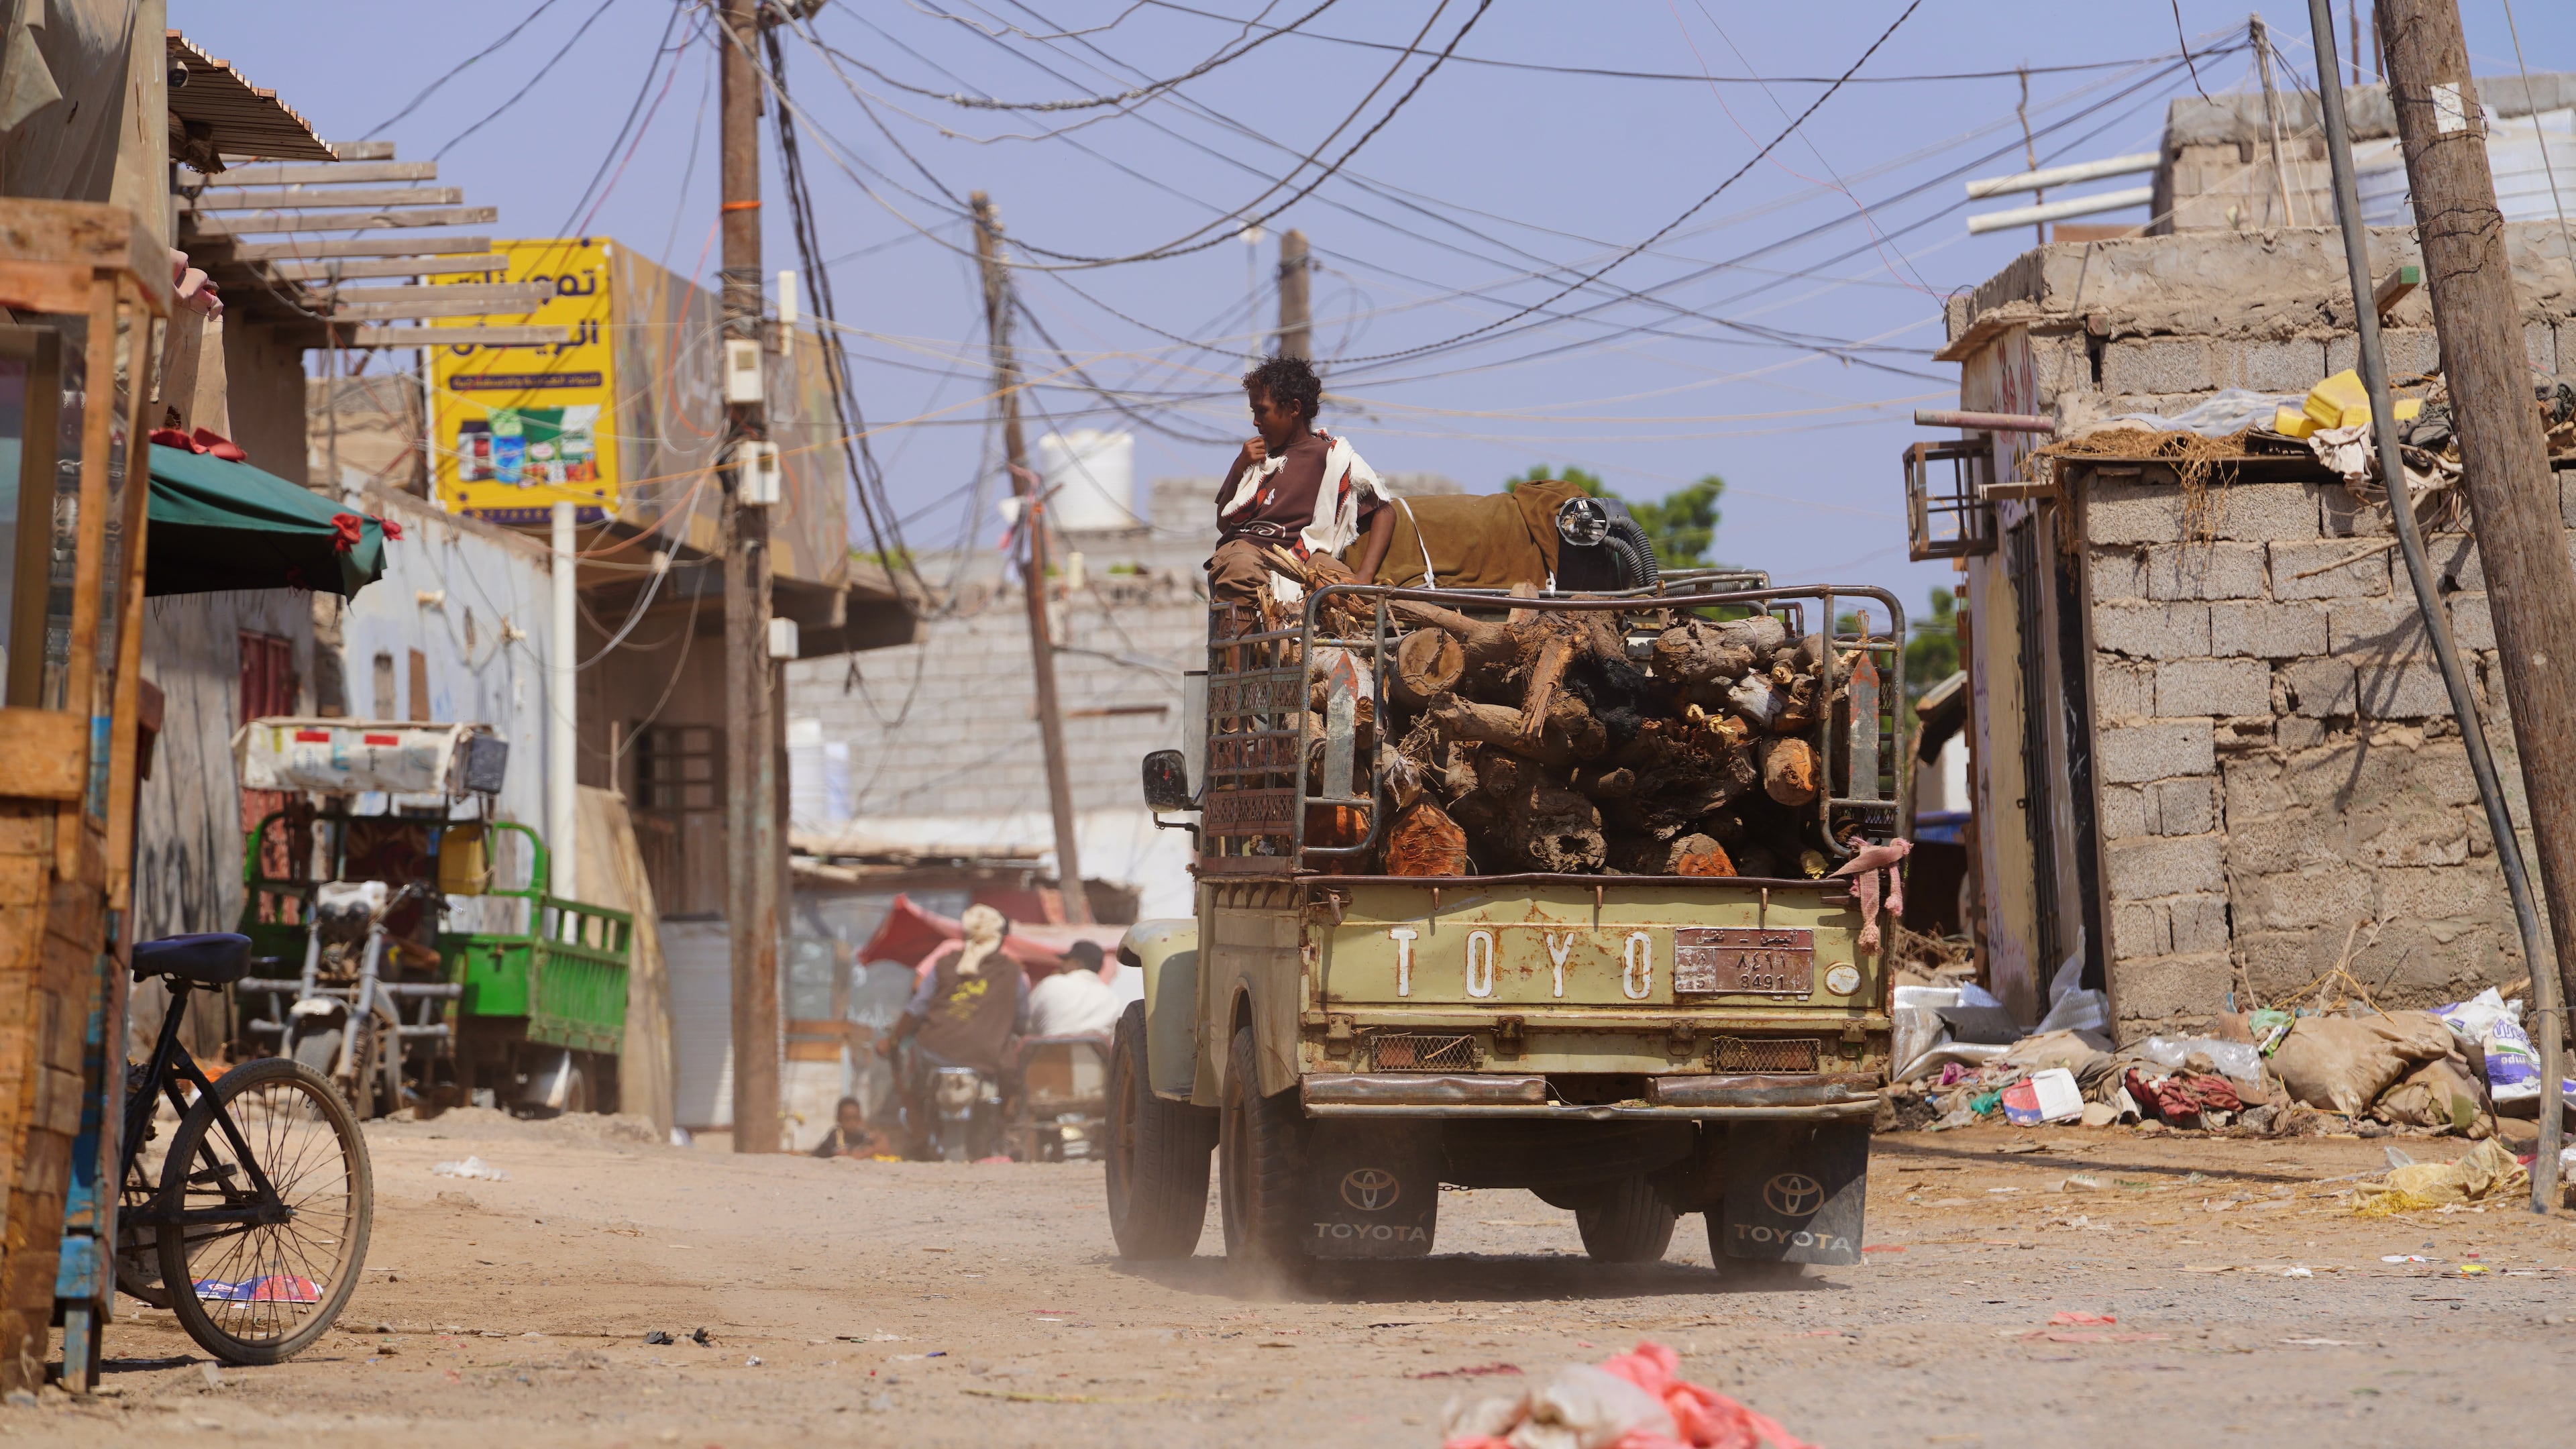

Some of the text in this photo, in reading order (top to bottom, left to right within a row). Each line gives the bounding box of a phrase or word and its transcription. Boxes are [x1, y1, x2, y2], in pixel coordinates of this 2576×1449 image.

[1697, 930, 1725, 945] نقل
[1760, 931, 1798, 947] اليمن
[1389, 930, 1652, 1000] TOYO
[1737, 951, 1786, 971] ٨٤٩١
[1740, 974, 1784, 989] 8491
[1313, 1222, 1428, 1241] TOYOTA
[1733, 1223, 1854, 1254] TOYOTA
